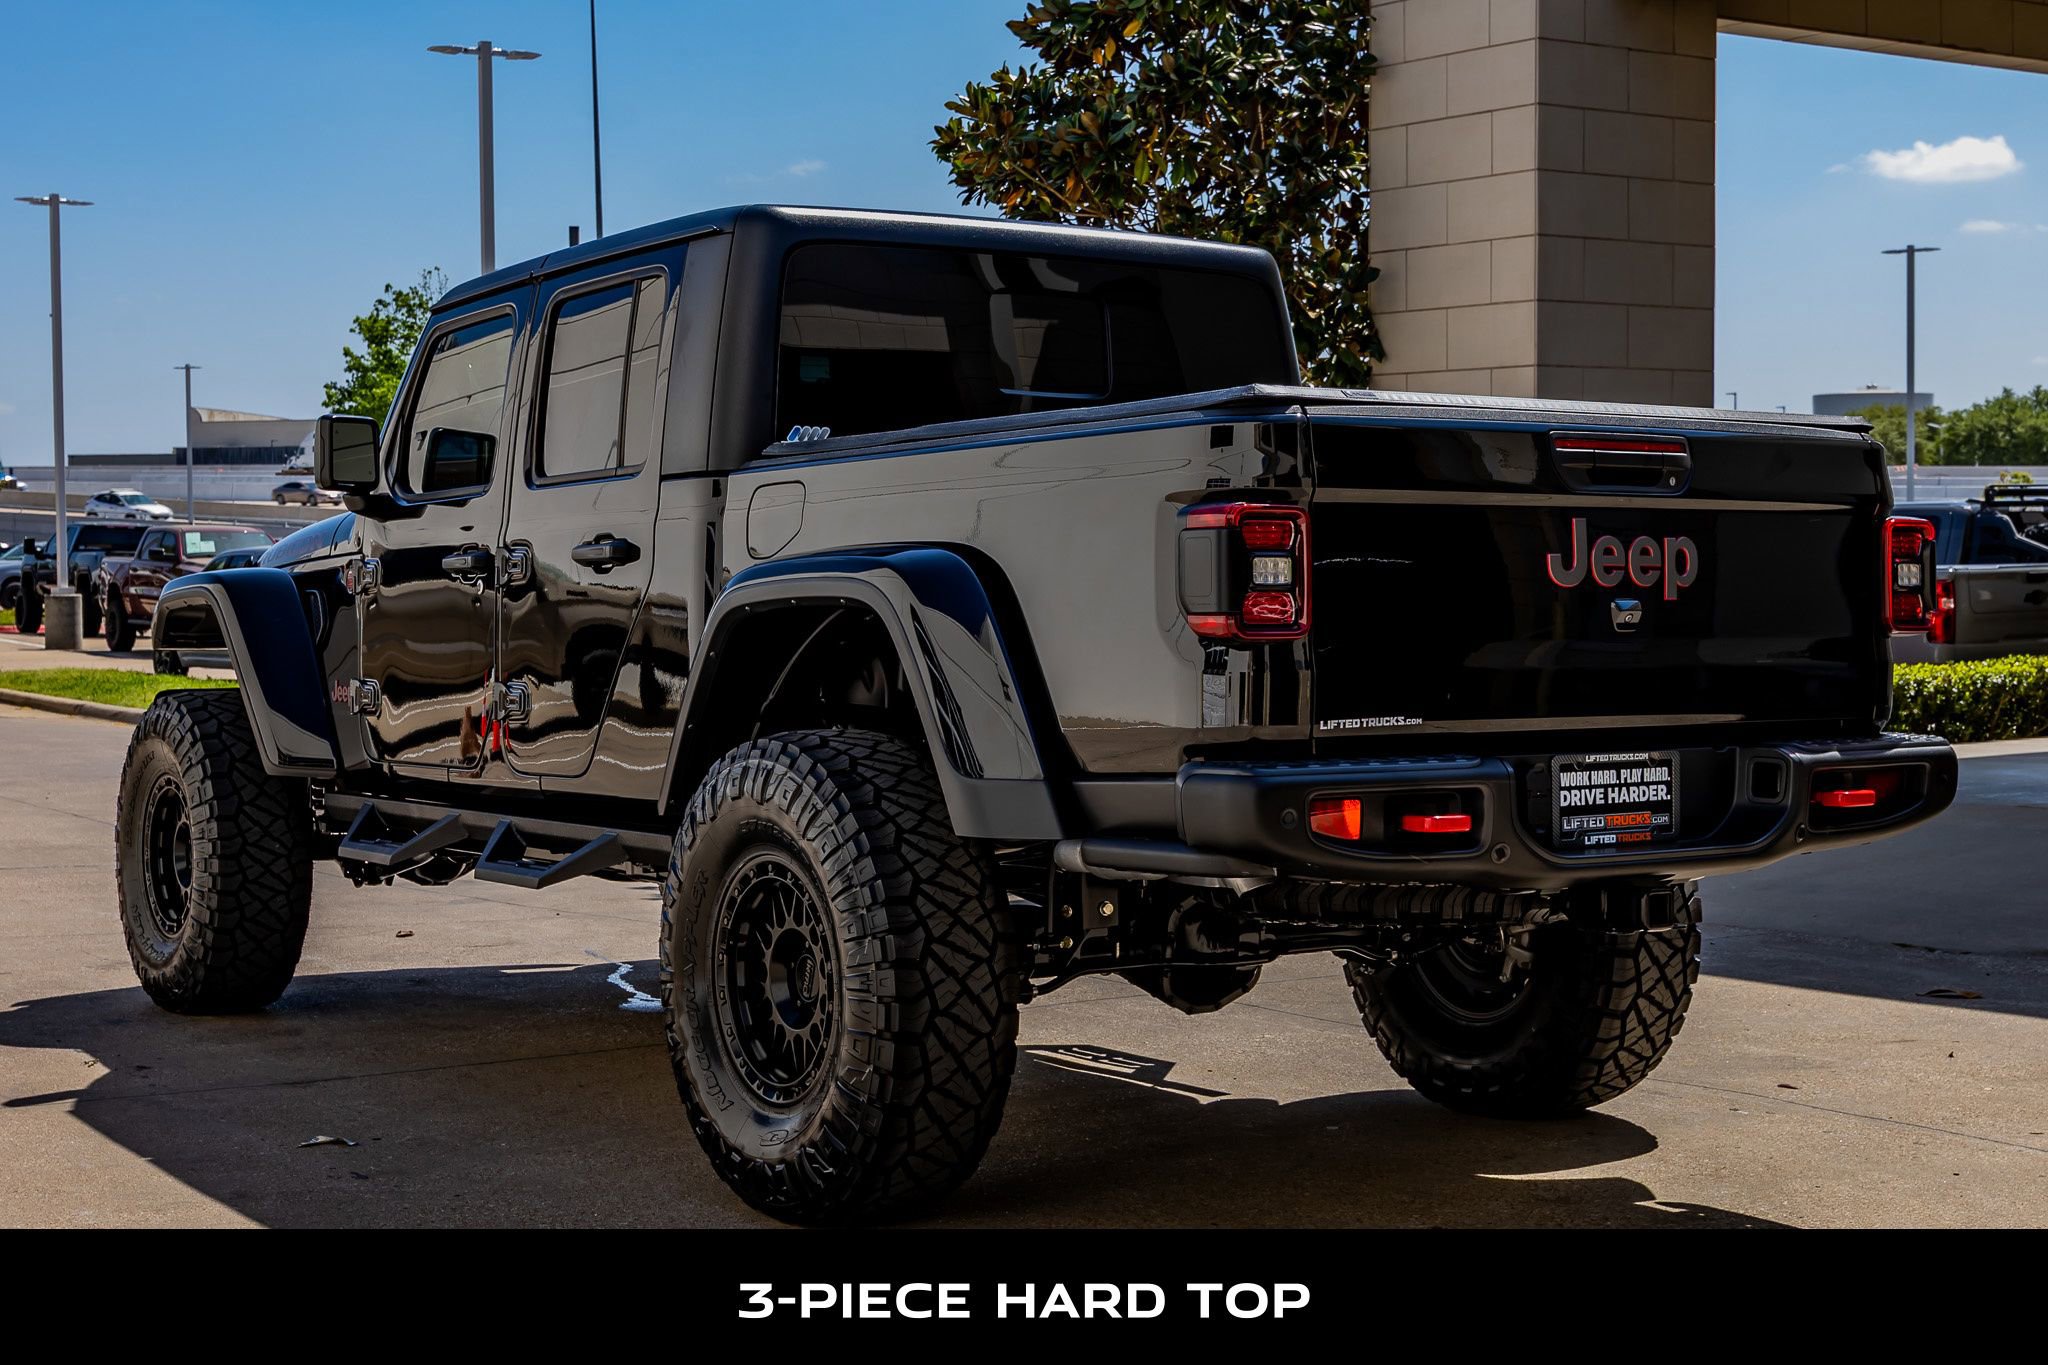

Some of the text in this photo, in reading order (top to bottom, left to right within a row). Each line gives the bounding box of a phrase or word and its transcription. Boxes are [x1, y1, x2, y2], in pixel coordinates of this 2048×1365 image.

[1546, 517, 1699, 600] Jeep
[1560, 767, 1671, 788] WORK HARD. PLAY HARD.
[1560, 784, 1671, 807] DRIVE HARDER.
